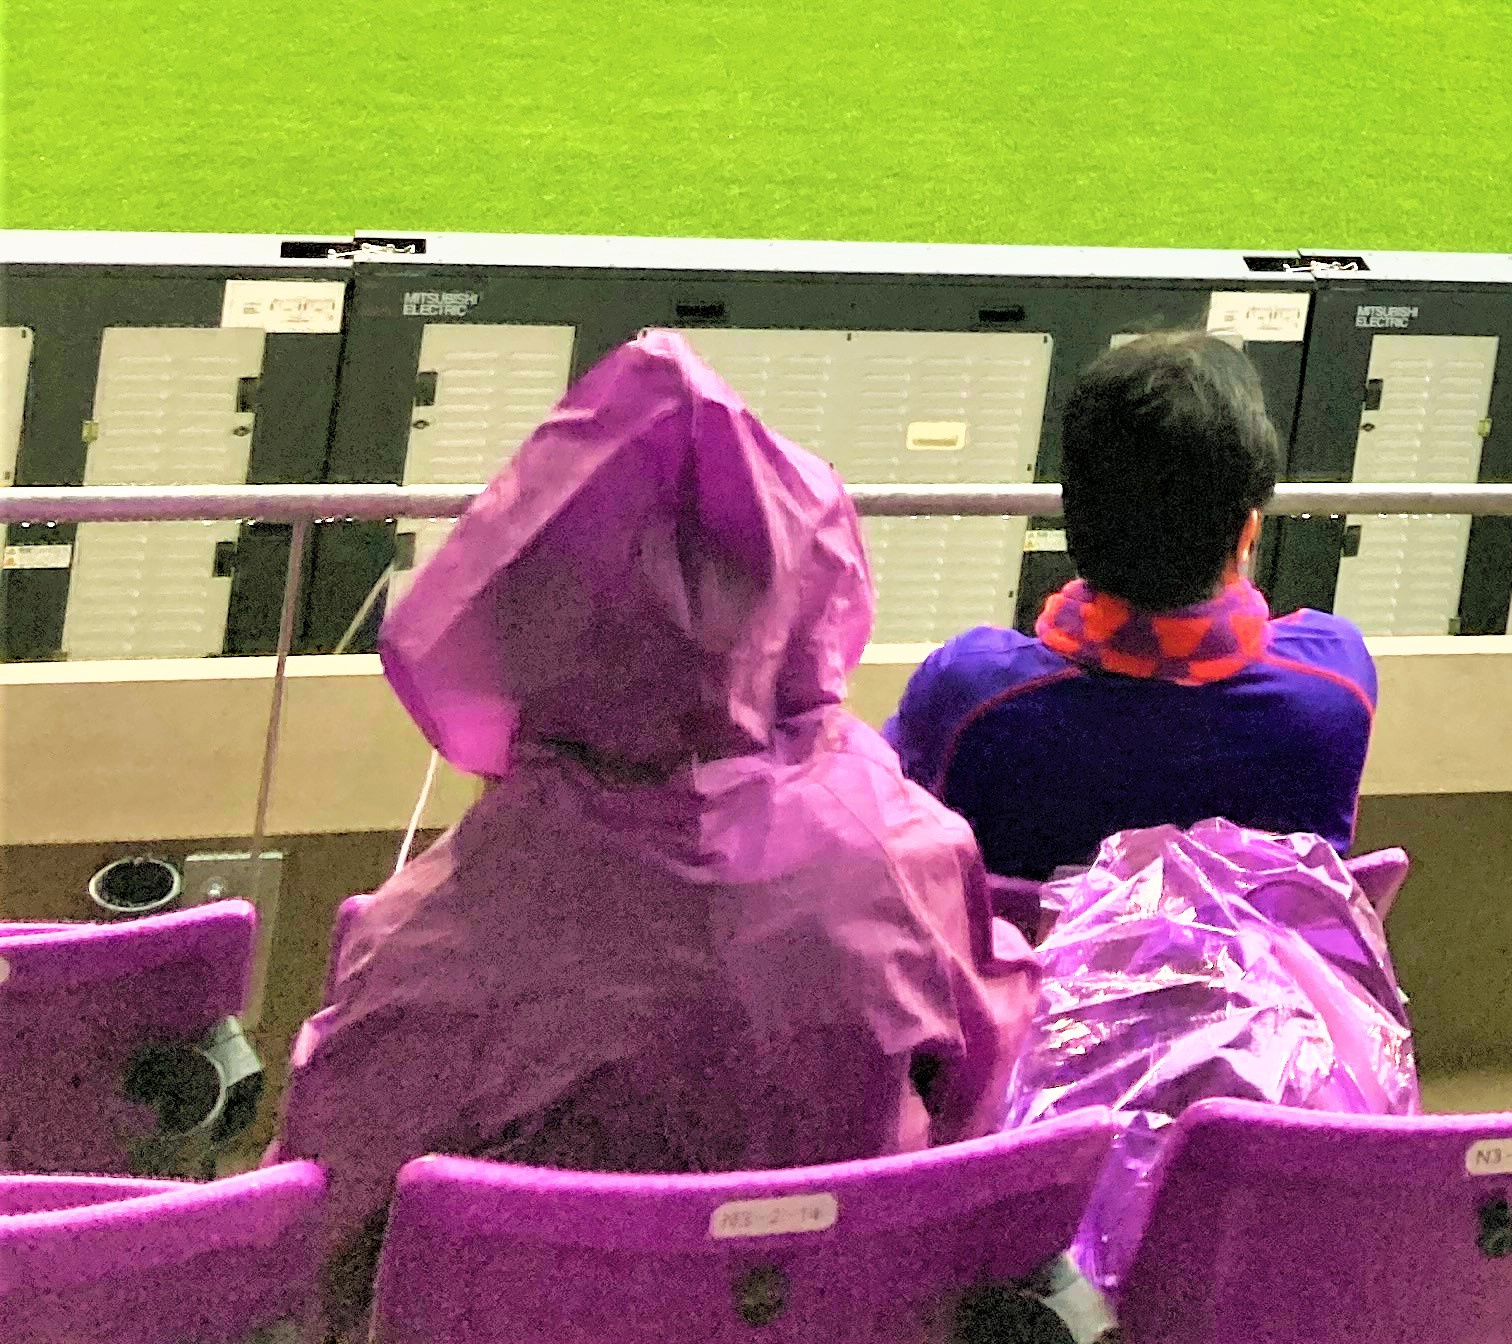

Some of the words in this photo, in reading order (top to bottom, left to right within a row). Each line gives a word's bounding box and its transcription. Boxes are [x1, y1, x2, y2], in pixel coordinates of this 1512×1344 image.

[404, 292, 480, 305] MITSUBISHI
[403, 305, 467, 316] ELECTRIC
[1357, 305, 1419, 317] MITSUBISHI
[1355, 317, 1409, 328] ELECTRIC
